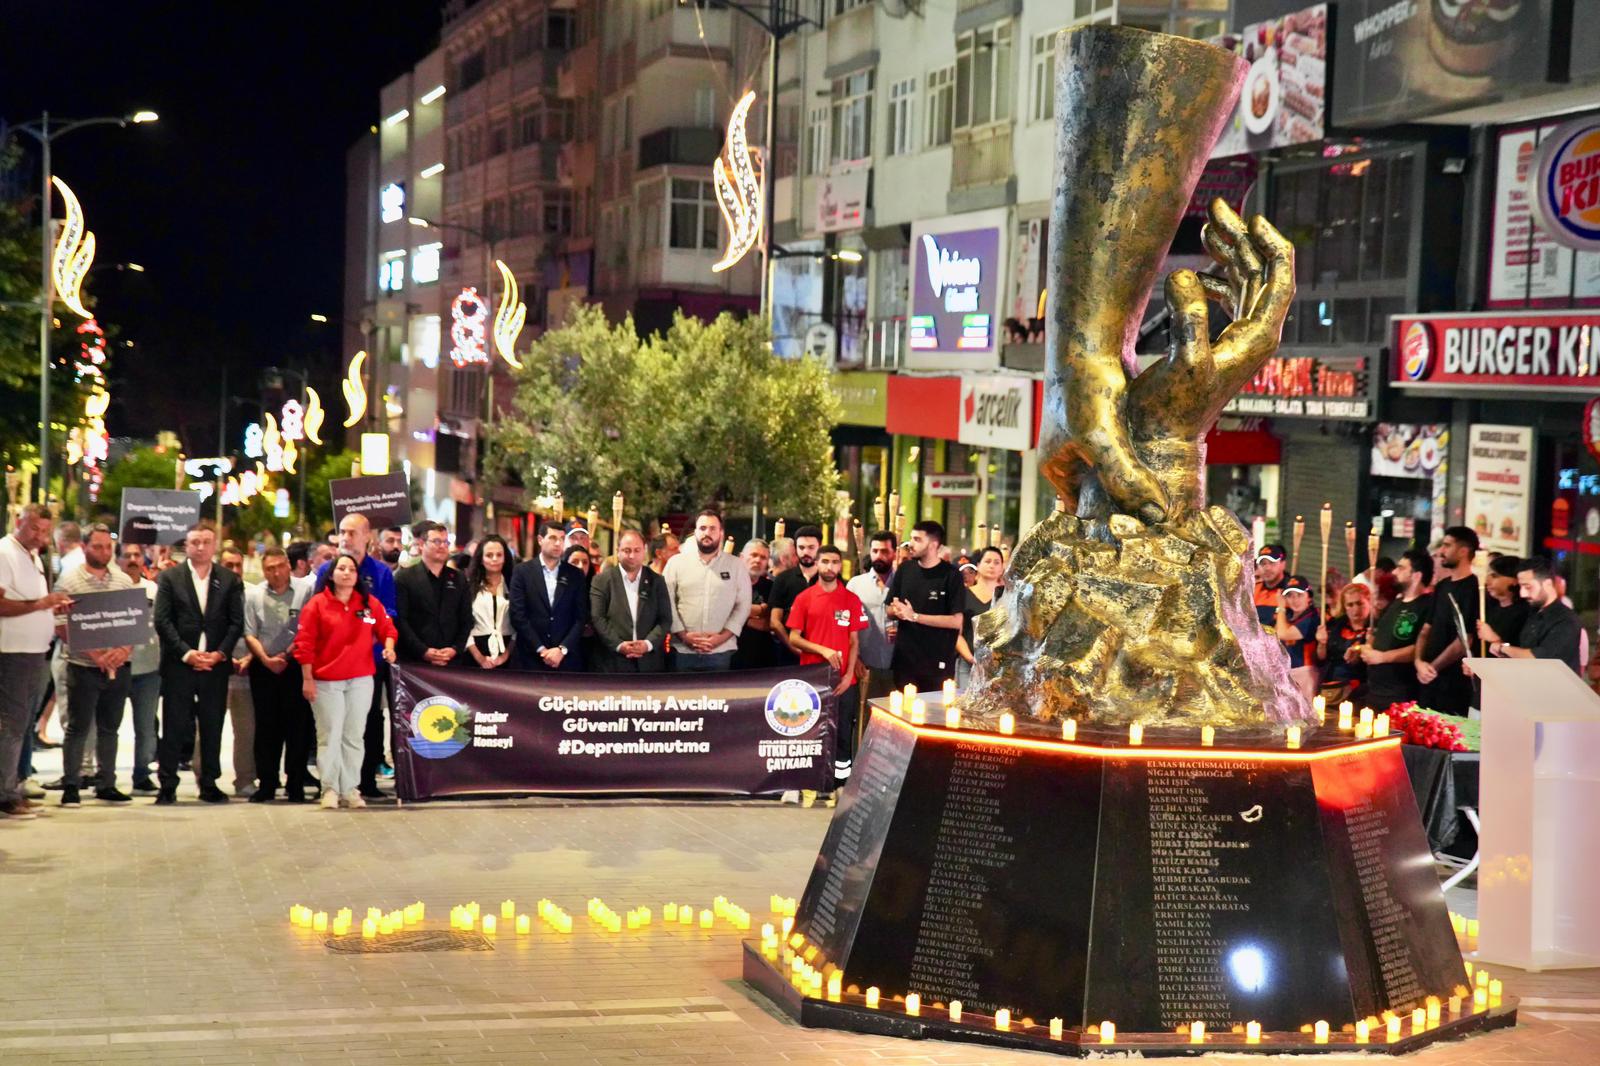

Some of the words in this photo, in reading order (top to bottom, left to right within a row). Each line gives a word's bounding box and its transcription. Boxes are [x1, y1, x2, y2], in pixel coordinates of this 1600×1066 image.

[1443, 326, 1551, 375] BURGER
[976, 388, 1022, 436] arçelik
[538, 696, 662, 714] Güçlendirilmiş
[664, 696, 730, 713] Avcılar,
[474, 724, 498, 735] Kent
[562, 718, 628, 732] Güvenli
[632, 718, 704, 732] Yarınlar!
[473, 736, 513, 750] Konseyi
[558, 738, 710, 758] #Depremiunutma
[758, 744, 787, 757] UTKU
[788, 744, 822, 756] CANER
[766, 756, 812, 773] ÇAYKARA
[1146, 759, 1177, 768] ELMAS
[1148, 786, 1183, 794] HİKMET
[1148, 795, 1187, 803] YASEMİN
[1167, 884, 1216, 892] KARAKAYA
